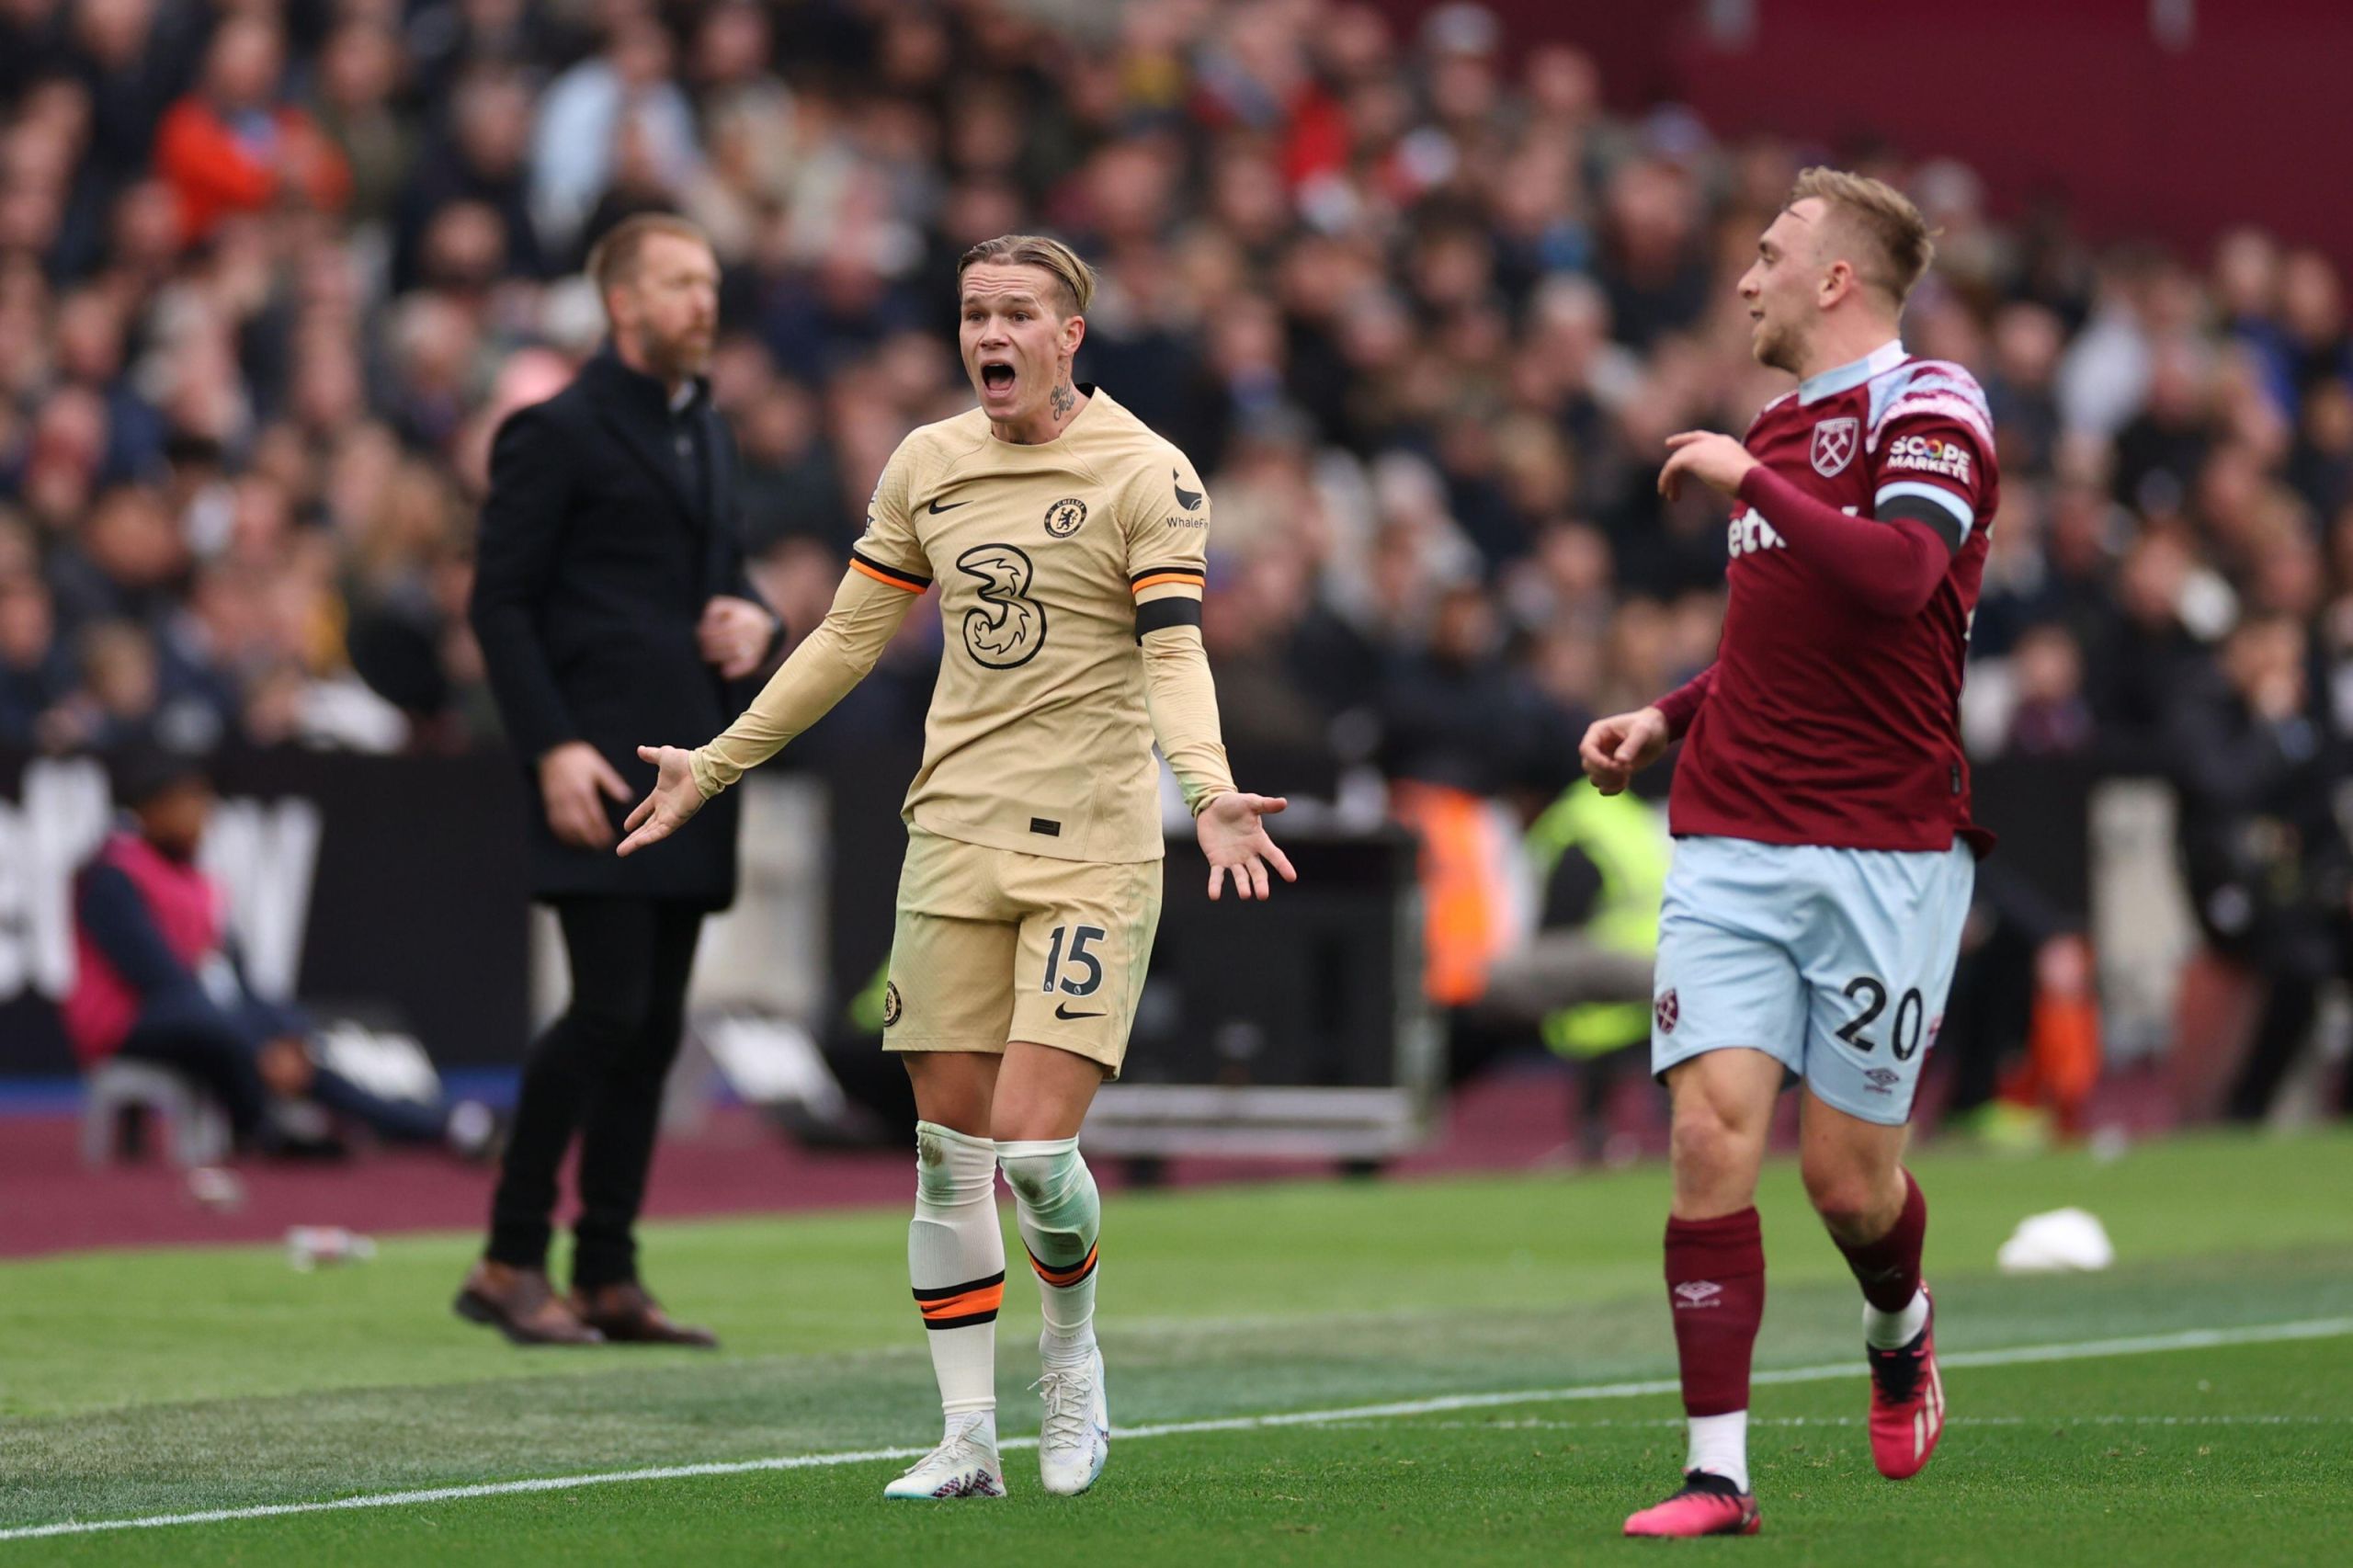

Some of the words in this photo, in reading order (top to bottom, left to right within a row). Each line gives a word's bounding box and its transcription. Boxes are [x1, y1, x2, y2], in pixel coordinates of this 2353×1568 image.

[1887, 454, 1970, 484] MARKETS
[1890, 436, 1971, 468] SCOPE
[1056, 498, 1086, 510] CHELSEA
[956, 543, 1047, 670] 3
[1042, 925, 1106, 996] 15
[1836, 976, 1923, 1061] 20
